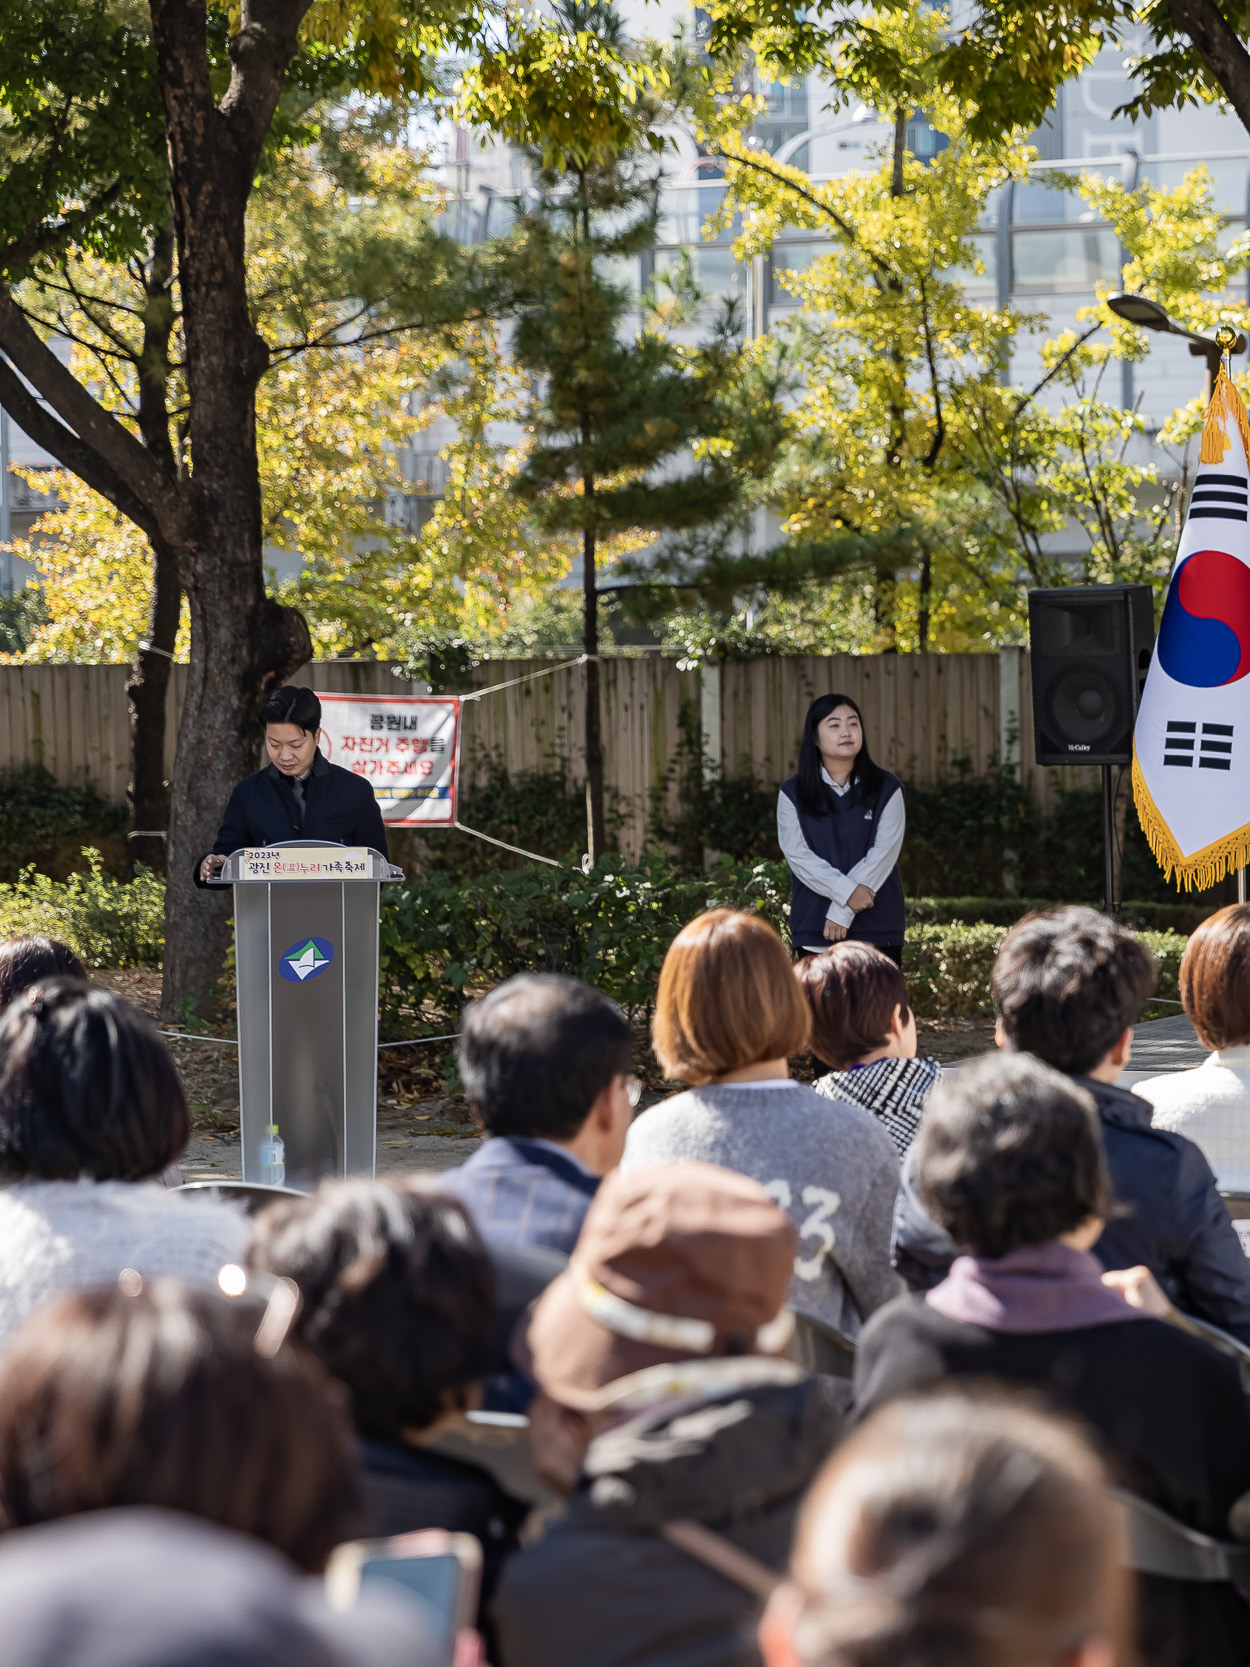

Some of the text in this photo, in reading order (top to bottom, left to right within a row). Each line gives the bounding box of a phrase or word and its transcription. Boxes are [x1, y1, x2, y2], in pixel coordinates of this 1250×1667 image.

[341, 736, 389, 752] 자전거
[249, 851, 280, 860] 2023년
[248, 862, 270, 874] 광진
[322, 861, 366, 873] 가족축제
